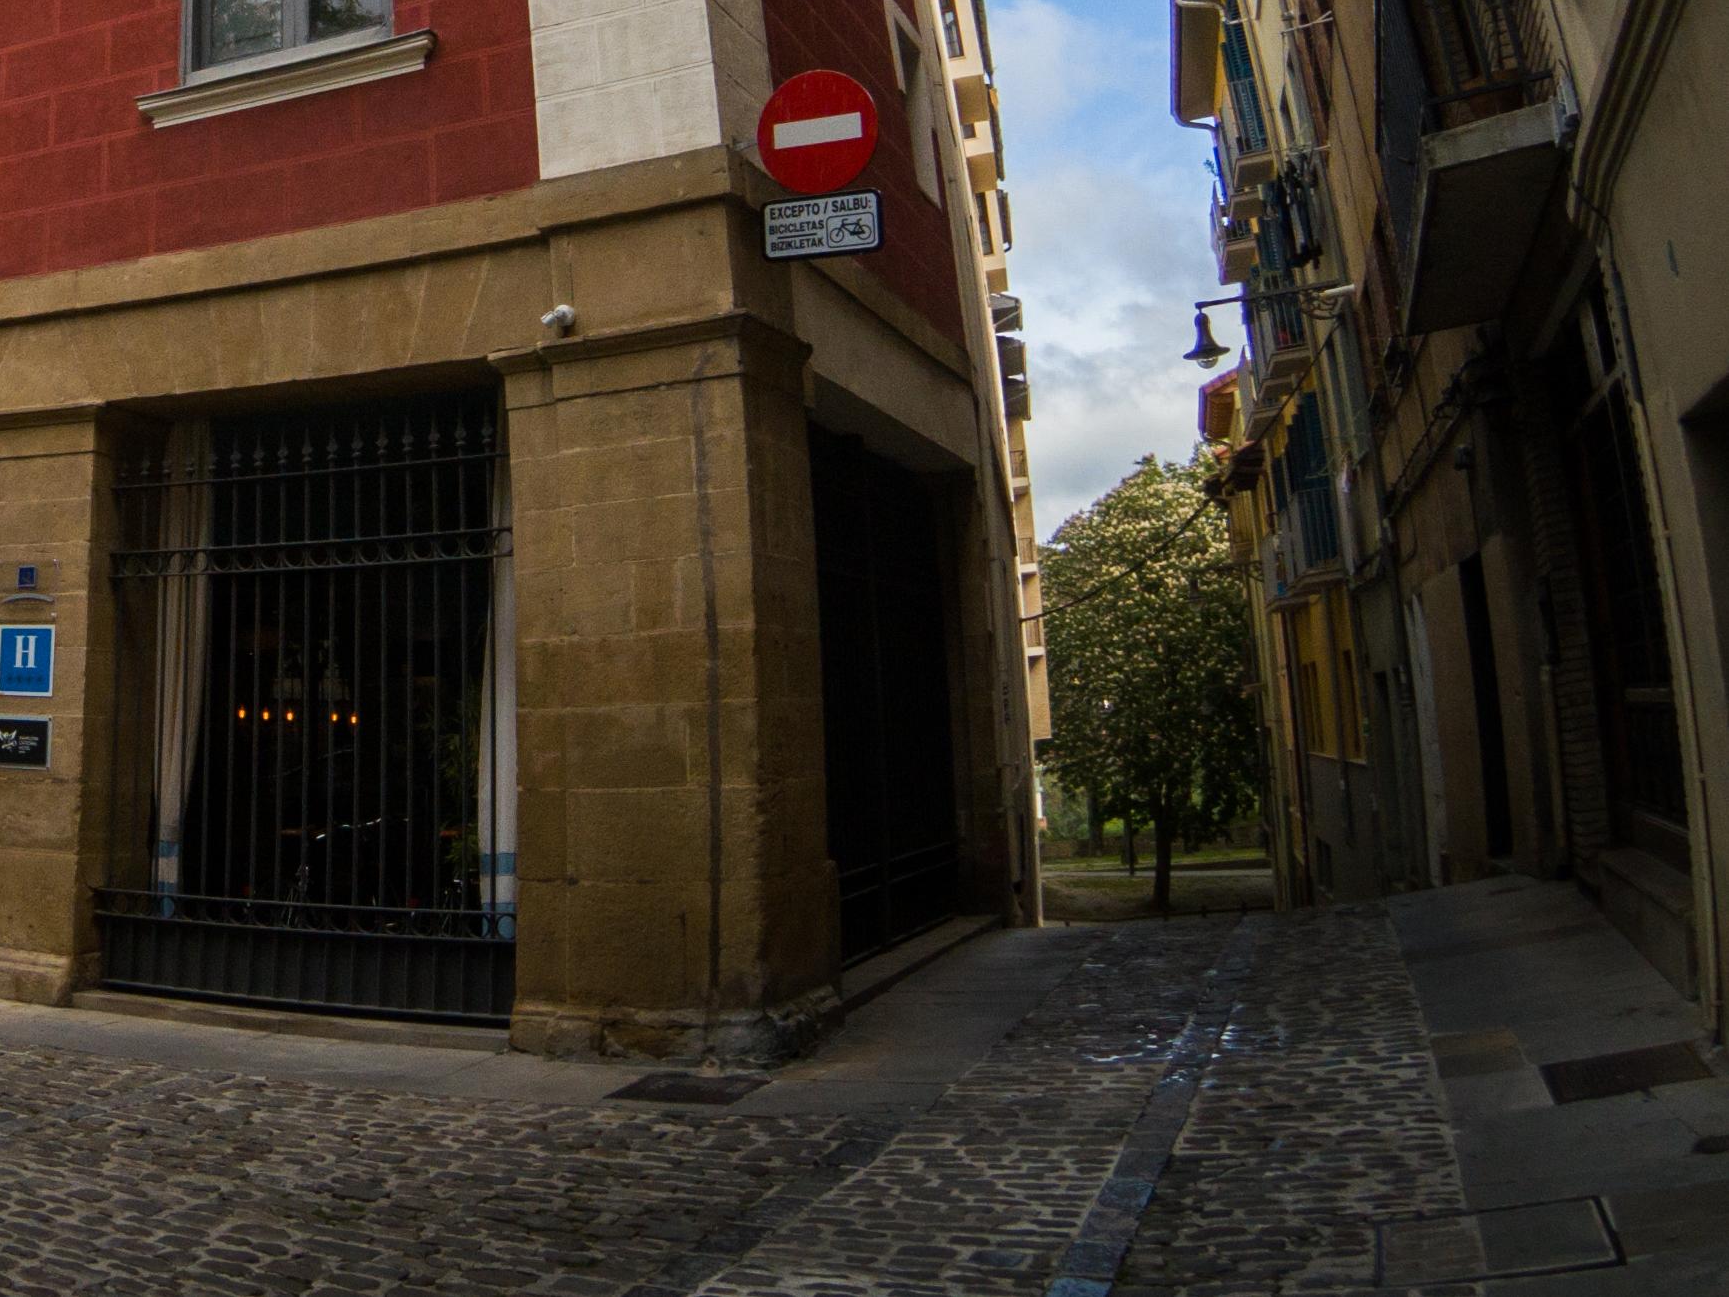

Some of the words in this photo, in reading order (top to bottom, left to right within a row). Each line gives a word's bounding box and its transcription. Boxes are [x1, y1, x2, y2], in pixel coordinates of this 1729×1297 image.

[770, 202, 820, 220] EXCEPTO
[769, 220, 824, 235] BICICLETAS
[771, 238, 824, 252] BIZIKLETAK
[14, 635, 38, 668] H
